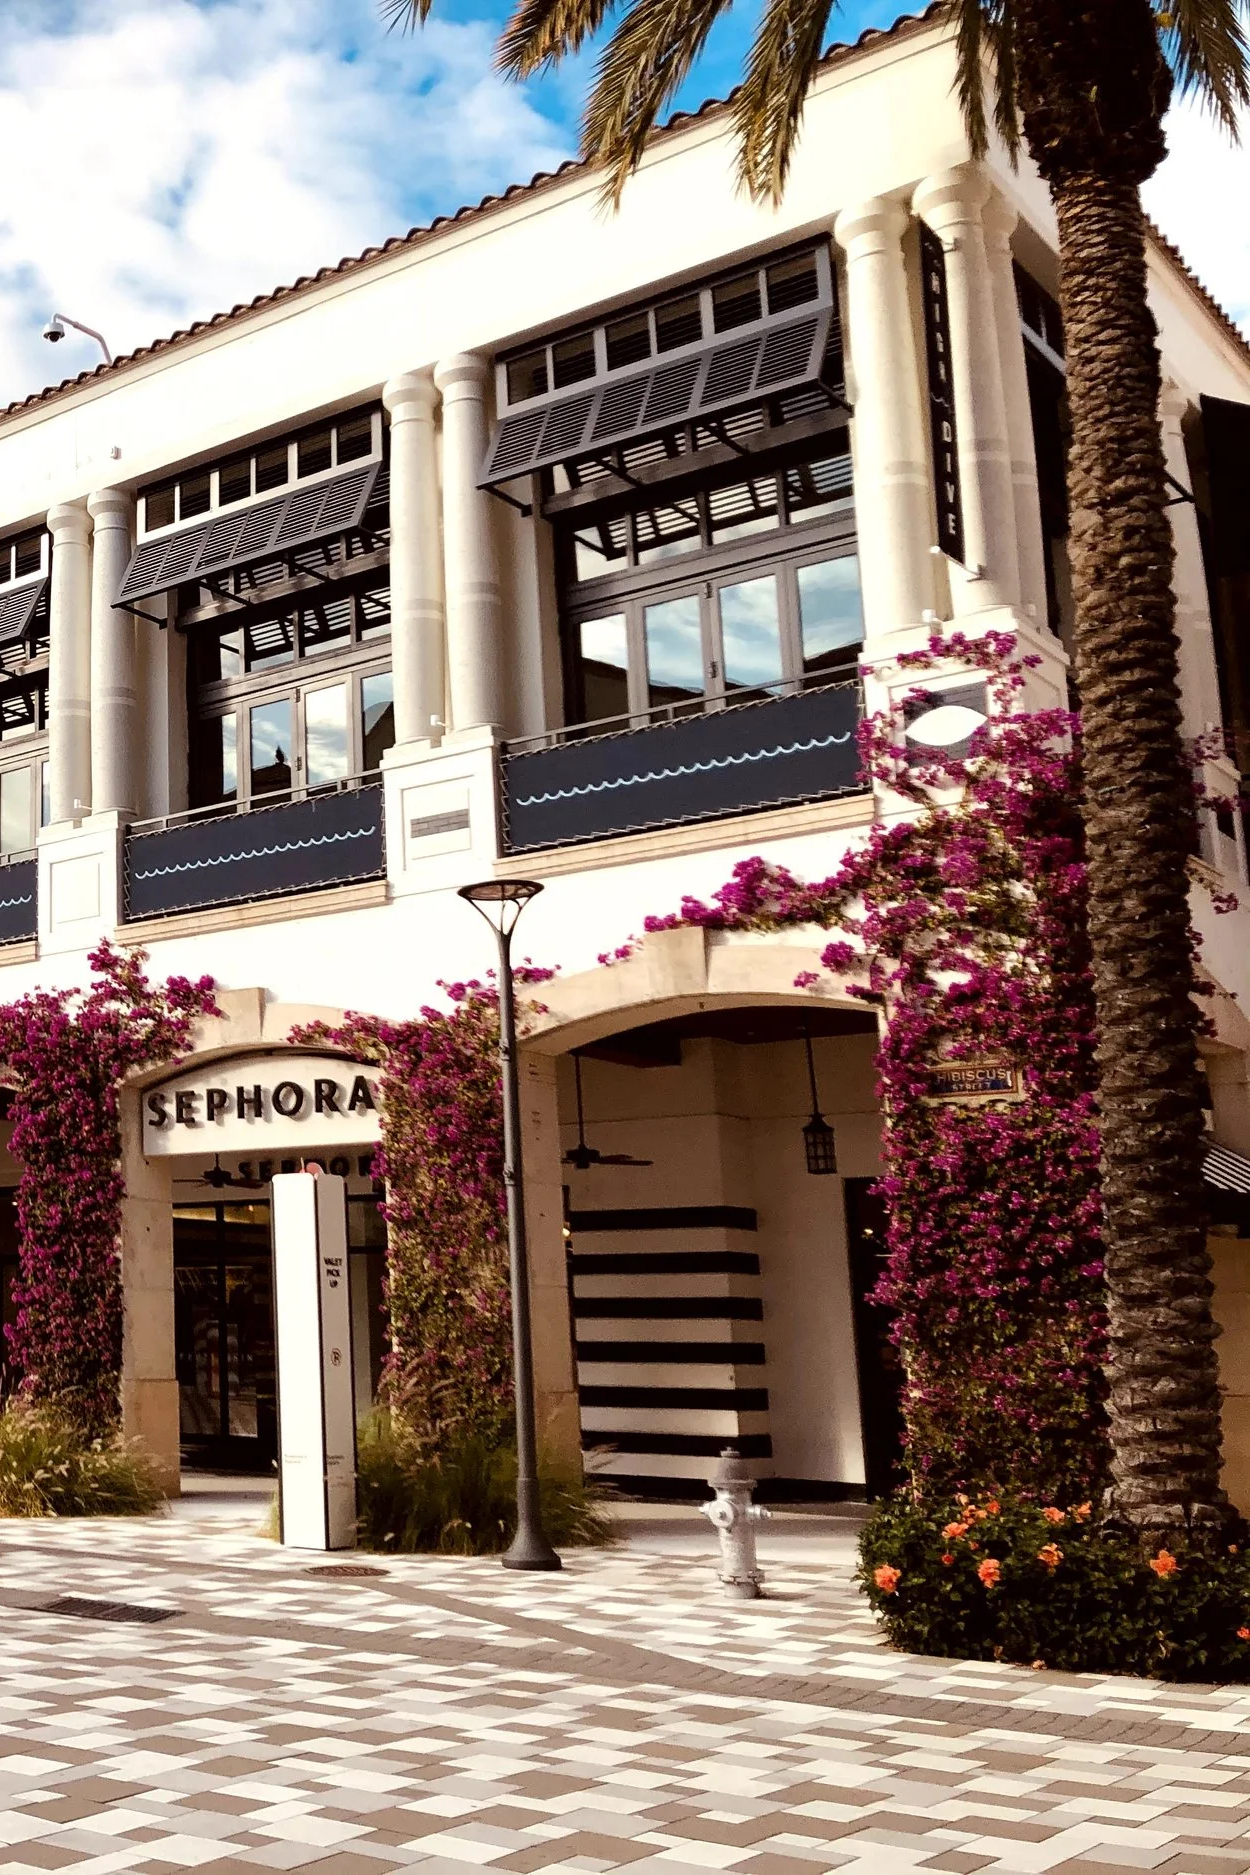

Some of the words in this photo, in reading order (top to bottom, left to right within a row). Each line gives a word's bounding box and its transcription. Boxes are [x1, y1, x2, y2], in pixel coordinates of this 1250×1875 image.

[941, 420, 956, 535] DIVE
[148, 1075, 377, 1126] SEPHORA
[936, 1068, 1007, 1083] HIBISCUS
